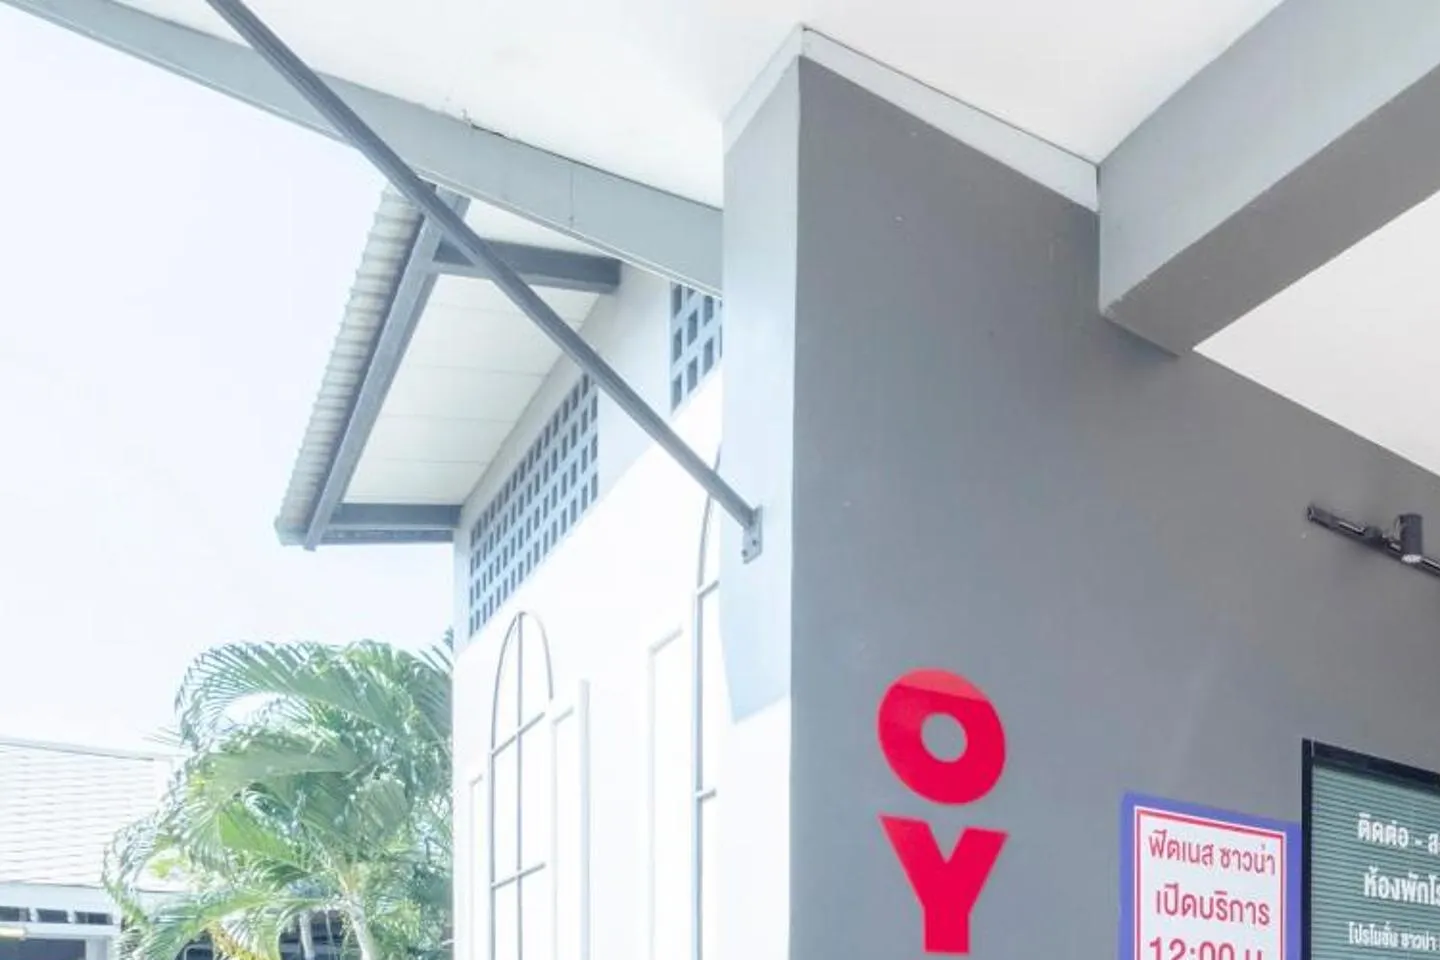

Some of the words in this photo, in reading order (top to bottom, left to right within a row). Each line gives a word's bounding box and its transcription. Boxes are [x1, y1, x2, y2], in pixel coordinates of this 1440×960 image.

[1357, 812, 1409, 848] ติดต่อ
[1219, 844, 1277, 876] ซาวน่า
[1156, 882, 1271, 926] เปิดบริการ
